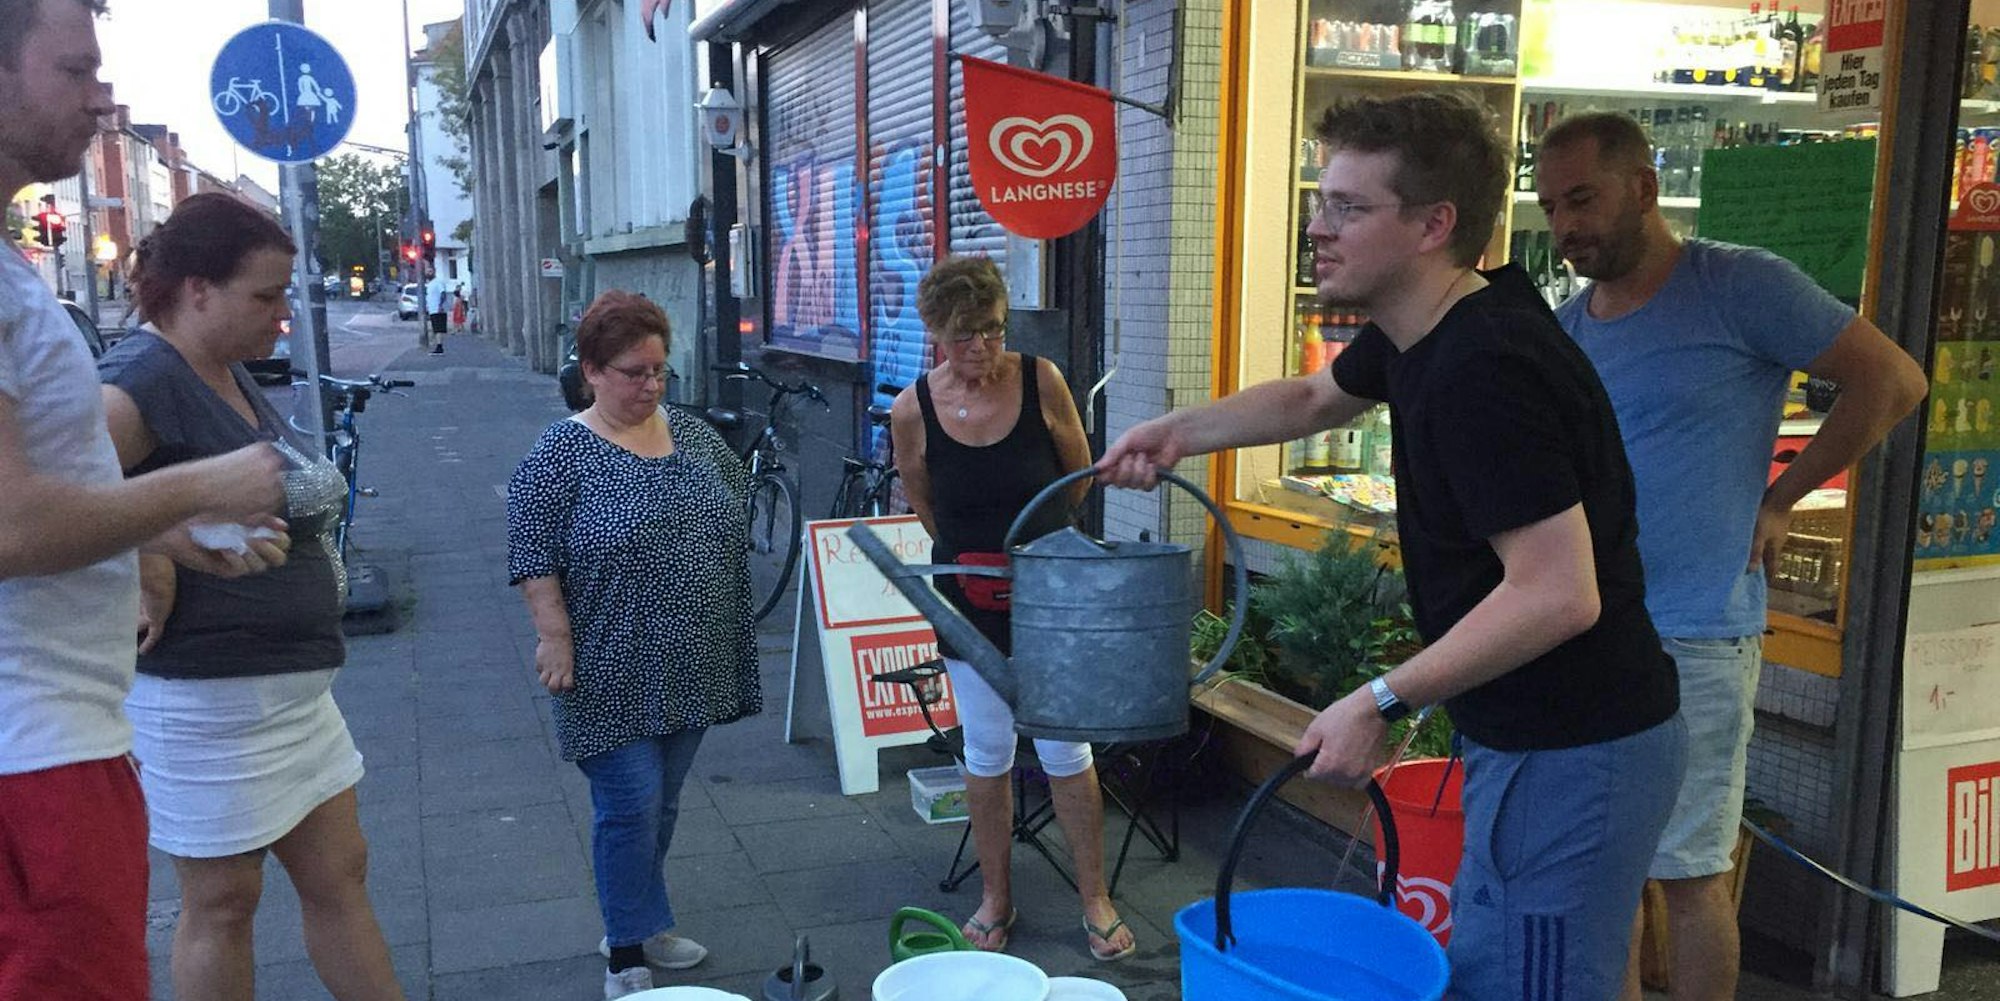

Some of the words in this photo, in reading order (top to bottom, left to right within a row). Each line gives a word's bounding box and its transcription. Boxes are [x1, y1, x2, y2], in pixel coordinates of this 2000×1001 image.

[1840, 54, 1865, 71] Hier
[1823, 74, 1856, 95] jeden
[1860, 70, 1880, 90] Tag
[1829, 90, 1870, 109] kaufen
[991, 181, 1097, 204] LANGNESE
